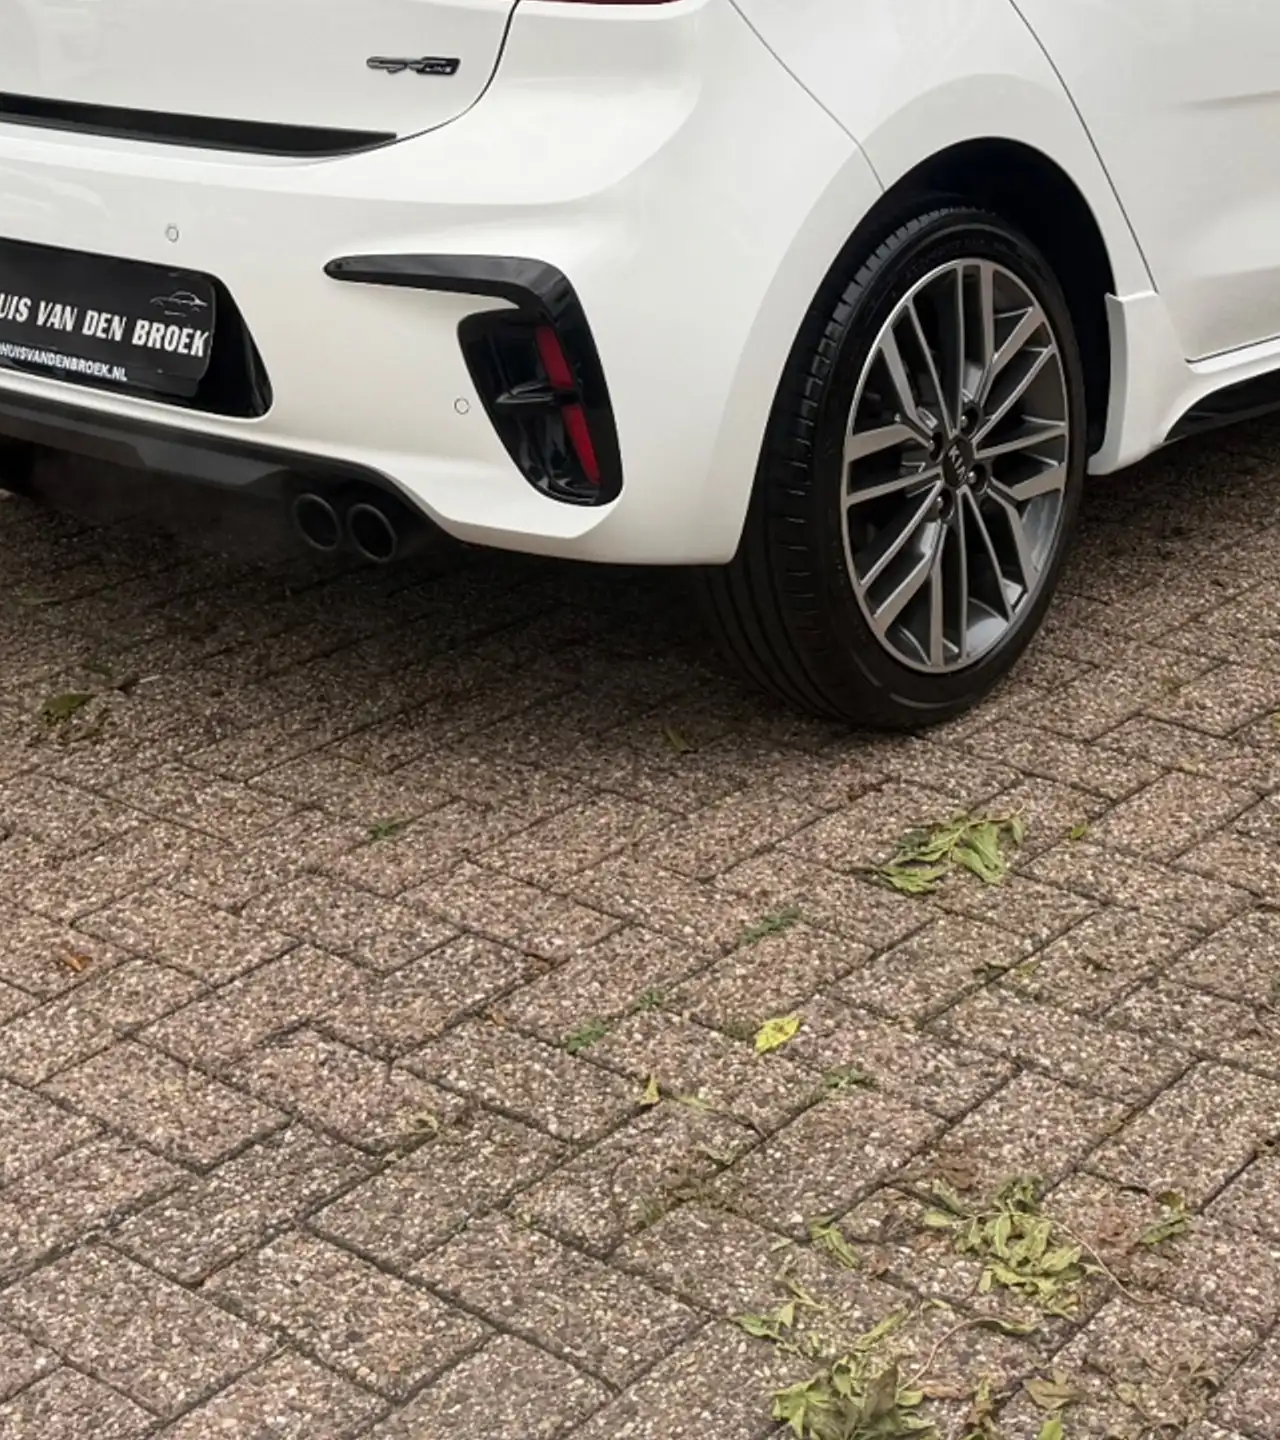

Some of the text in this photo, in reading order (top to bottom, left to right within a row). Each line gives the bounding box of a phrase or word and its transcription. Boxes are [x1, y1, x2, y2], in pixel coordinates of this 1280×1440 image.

[36, 300, 79, 332] VAN
[82, 309, 128, 341] DEN
[132, 318, 209, 357] BROEK
